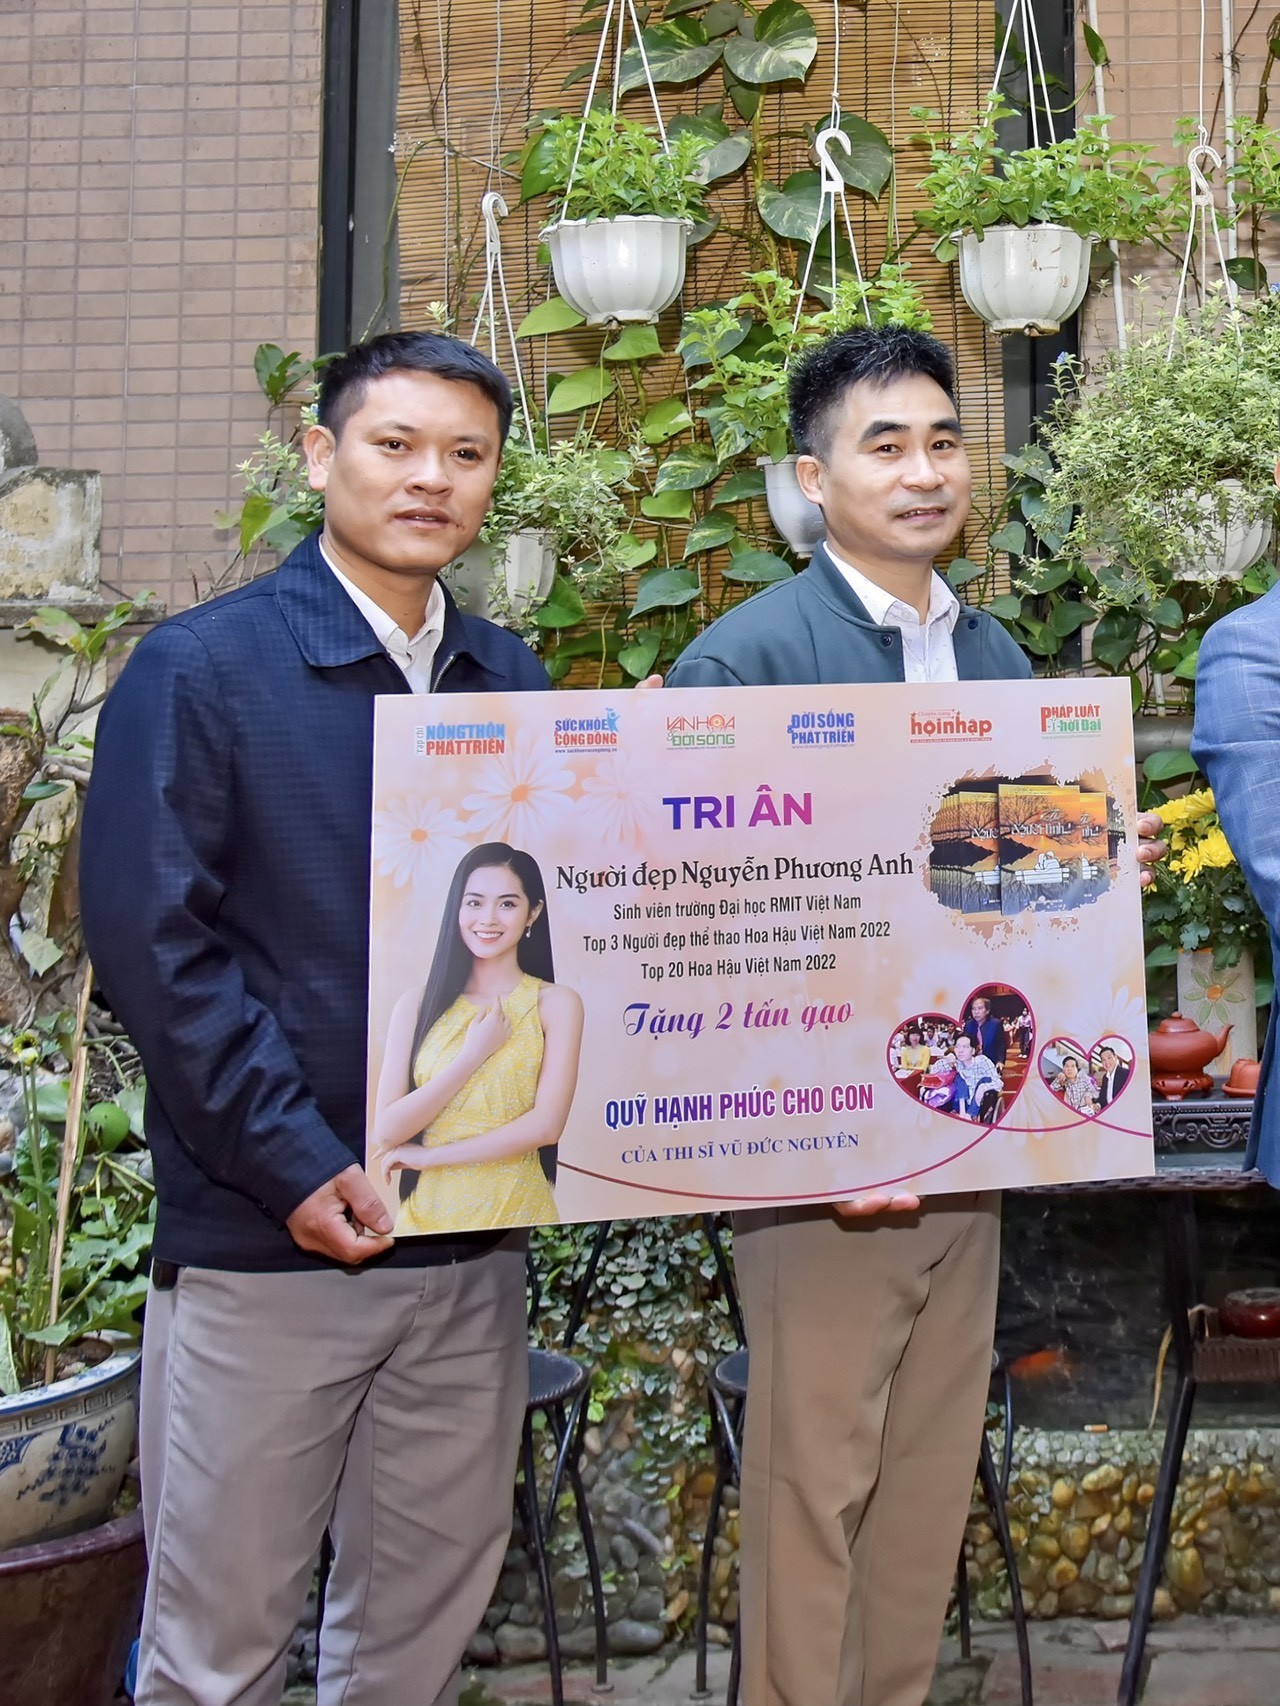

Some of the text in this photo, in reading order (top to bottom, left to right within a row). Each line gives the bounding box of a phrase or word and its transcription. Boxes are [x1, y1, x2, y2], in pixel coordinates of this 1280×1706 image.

[791, 708, 855, 729] ĐỜI SỐNG
[1041, 704, 1073, 732] PHÁP
[663, 784, 812, 830] TRI ÂN
[556, 852, 914, 894] Người đẹp Nguyễn Phương Anh
[613, 894, 861, 920] Sinh viên trường Đại học RMIT Việt Nam
[583, 921, 891, 954] Top 3 Người đẹp thể thao Hoa Hậu Việt Nam 2022
[641, 953, 836, 982] Top 20 Hoa Hậu Việt Nam 2022
[623, 998, 854, 1041] Tặng 2 tấn gạo
[605, 1084, 874, 1130] QUỸ HẠNH PHÚC CHO CON
[621, 1131, 859, 1164] CỦA THI SĨ VŨ ĐỨC NGUYÊN
